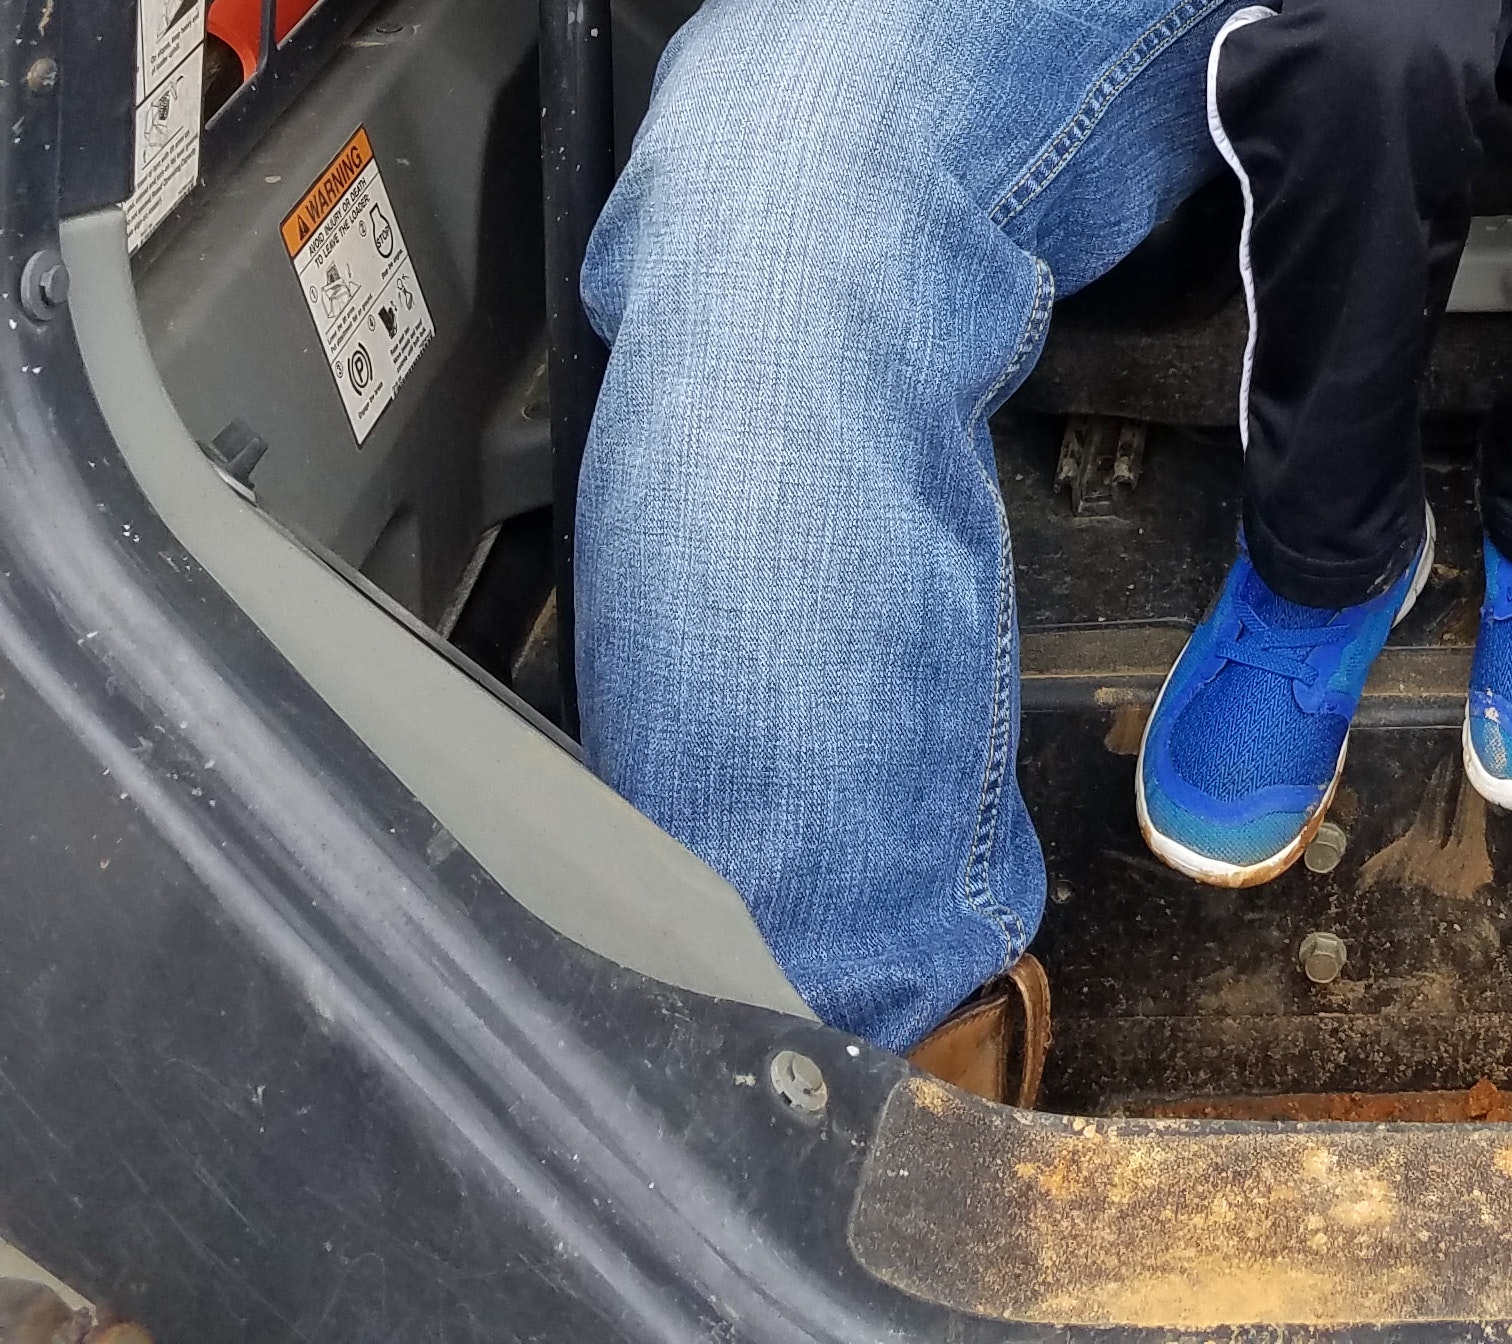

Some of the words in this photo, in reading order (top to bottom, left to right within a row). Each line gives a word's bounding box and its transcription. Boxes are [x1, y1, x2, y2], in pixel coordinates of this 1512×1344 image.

[304, 145, 362, 226] WARNING
[307, 230, 324, 256] AVOID
[323, 207, 342, 236] INJURY
[341, 196, 350, 212] OR
[349, 176, 366, 202] DEATH
[314, 252, 323, 270] TO
[322, 232, 339, 259] LEAVE
[338, 218, 350, 237] THE
